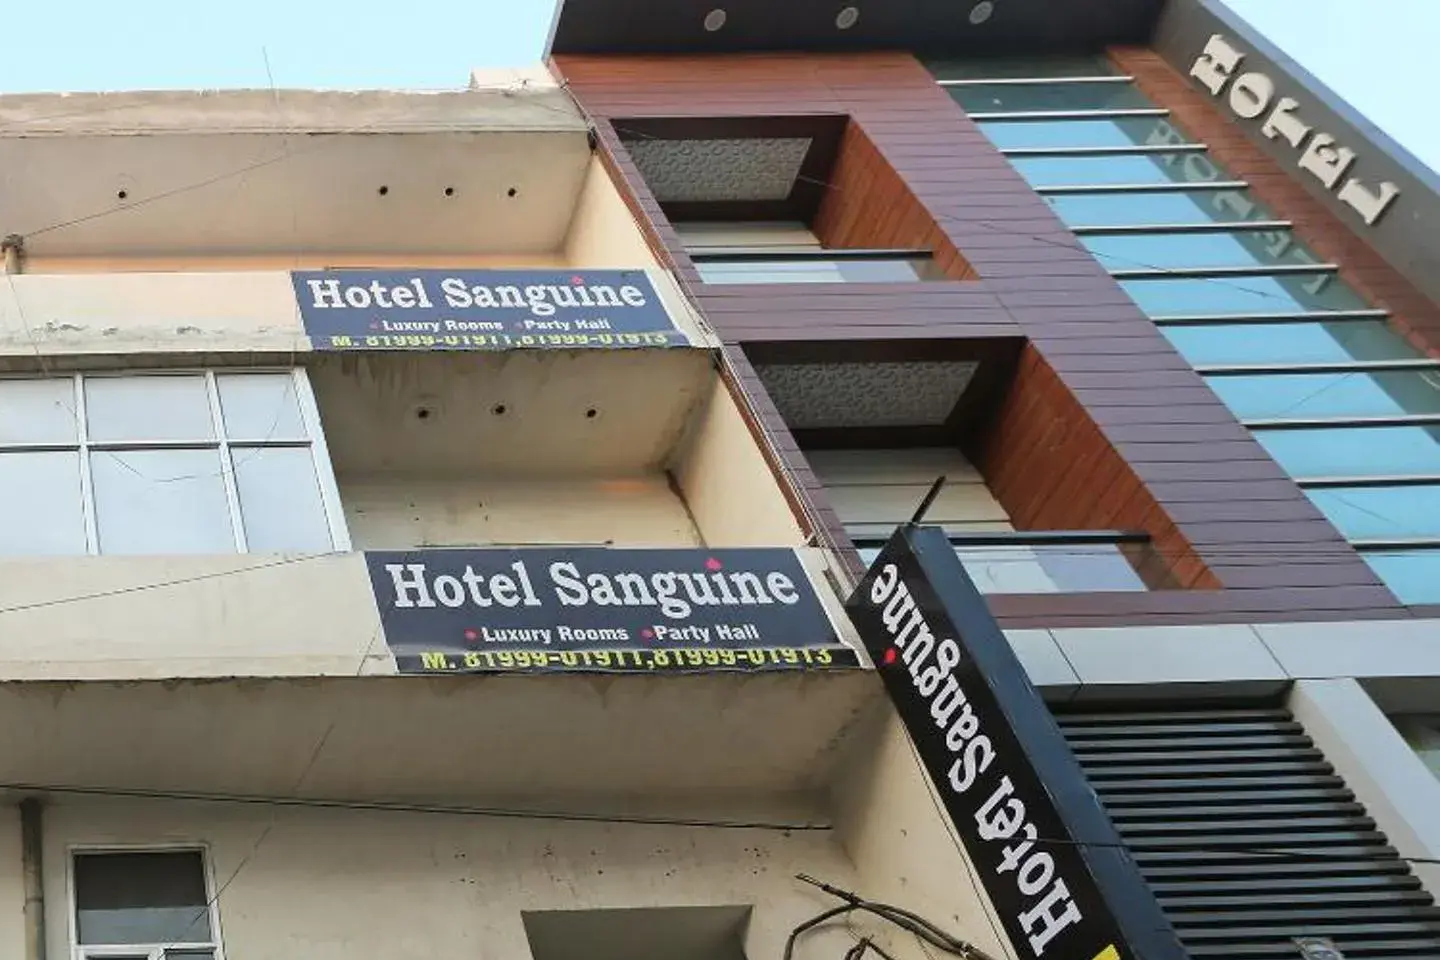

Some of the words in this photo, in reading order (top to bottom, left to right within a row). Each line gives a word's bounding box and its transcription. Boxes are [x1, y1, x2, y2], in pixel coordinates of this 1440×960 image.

[1190, 34, 1400, 225] HOTEL
[307, 278, 433, 309] Hotel
[442, 275, 646, 315] Sanguine
[383, 320, 442, 332] Luxury
[446, 320, 502, 331] Rooms
[524, 319, 572, 331] Party
[577, 317, 610, 330] Hall
[385, 562, 541, 608] Hotel
[549, 558, 800, 619] Sanguine
[481, 626, 553, 644] Luxury
[558, 626, 629, 641] Rooms
[654, 625, 710, 643] Party
[715, 624, 759, 640] Hall
[871, 564, 996, 794] Sanguine
[973, 775, 1083, 958] Hotel
